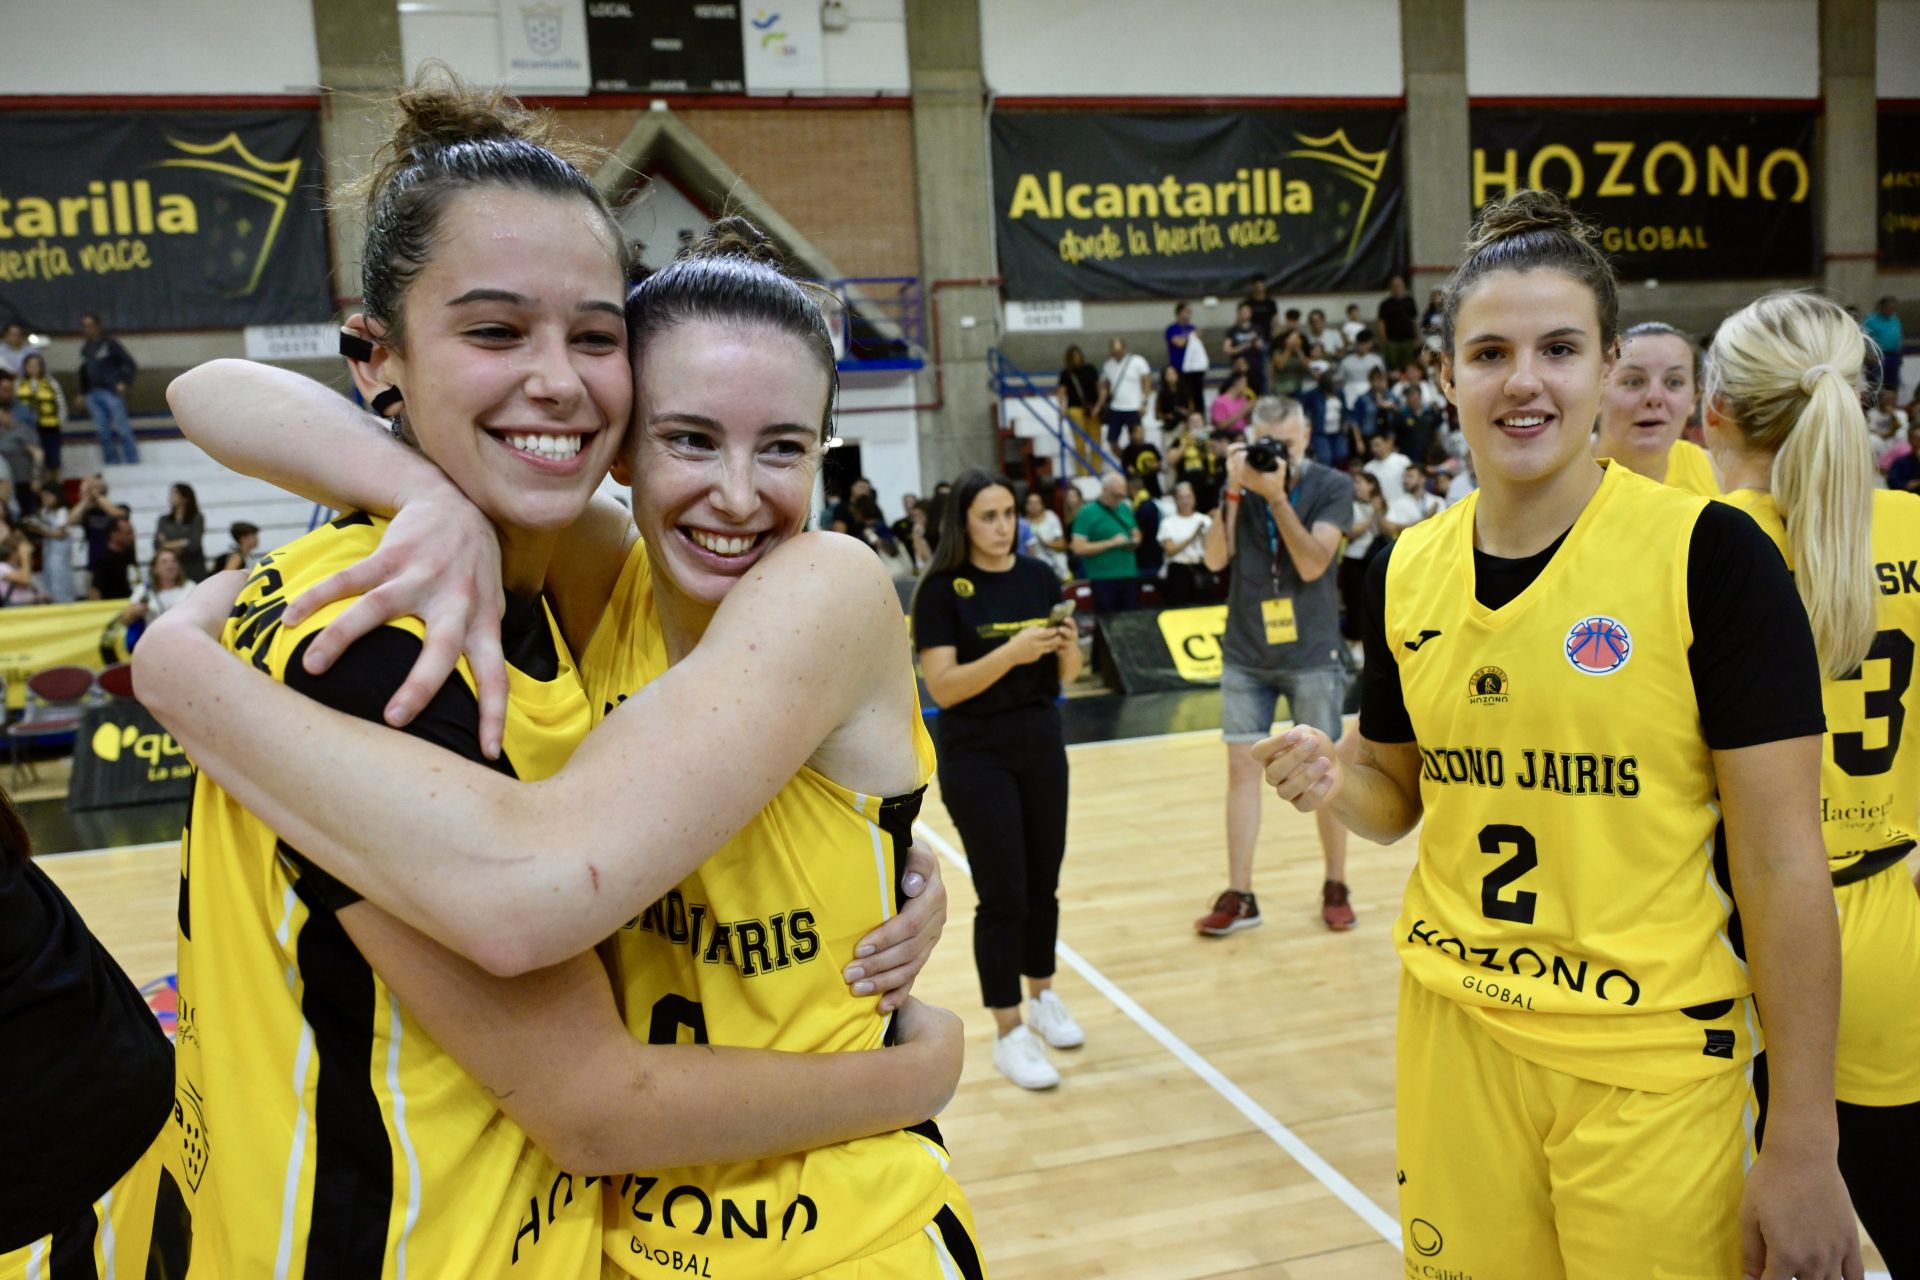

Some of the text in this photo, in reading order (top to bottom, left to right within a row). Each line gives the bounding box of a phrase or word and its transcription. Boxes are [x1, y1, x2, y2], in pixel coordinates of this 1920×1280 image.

[1008, 168, 1313, 220] Alcantarilla
[1473, 141, 1810, 207] HOZONO
[79, 239, 152, 274] nace
[1059, 217, 1280, 264] donde la huerta nace
[1602, 225, 1708, 252] GLOBAL
[1875, 560, 1920, 596] SK
[1831, 628, 1915, 777] 3
[1421, 746, 1640, 799] OZONO JAIRIS
[1478, 824, 1538, 925] 2
[1407, 919, 1641, 1006] HOZONO
[1462, 975, 1536, 1012] GLOBAL
[630, 1235, 712, 1279] GLOBAL
